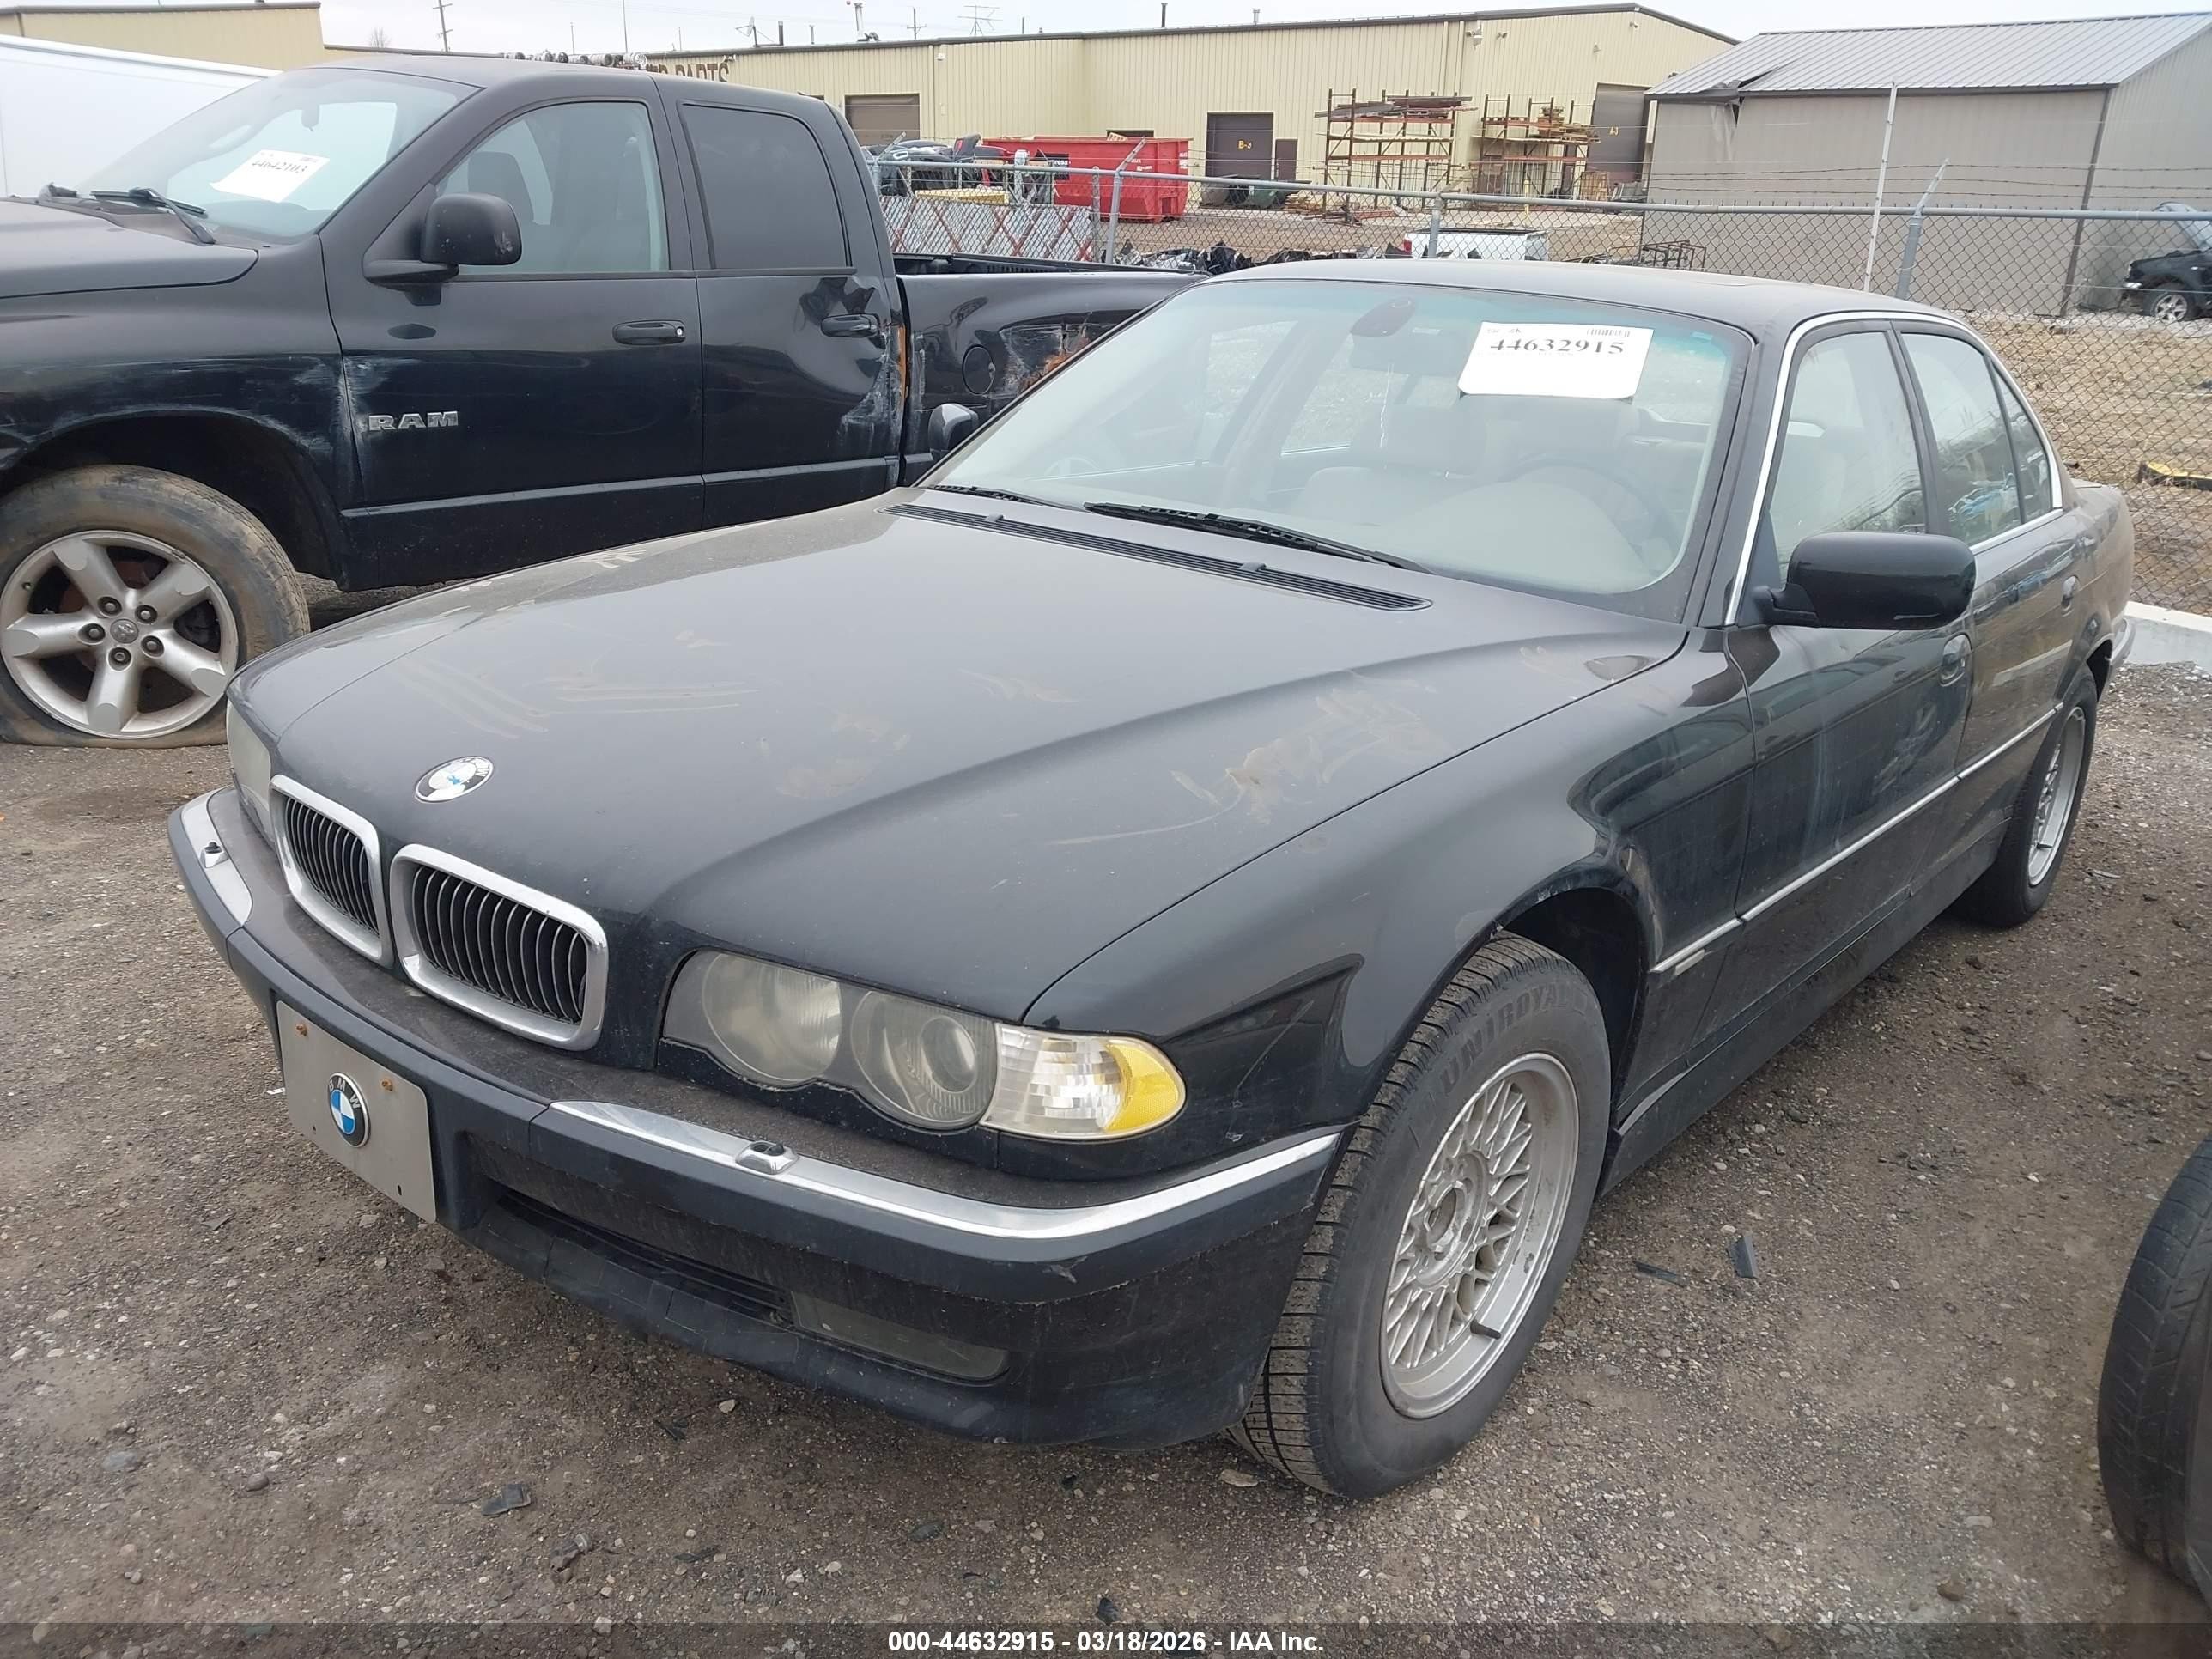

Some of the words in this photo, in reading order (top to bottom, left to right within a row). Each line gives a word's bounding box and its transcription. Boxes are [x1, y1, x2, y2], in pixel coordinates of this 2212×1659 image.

[1490, 338, 1626, 355] 44632915
[368, 410, 459, 431] RAM
[328, 1077, 362, 1109] BMW
